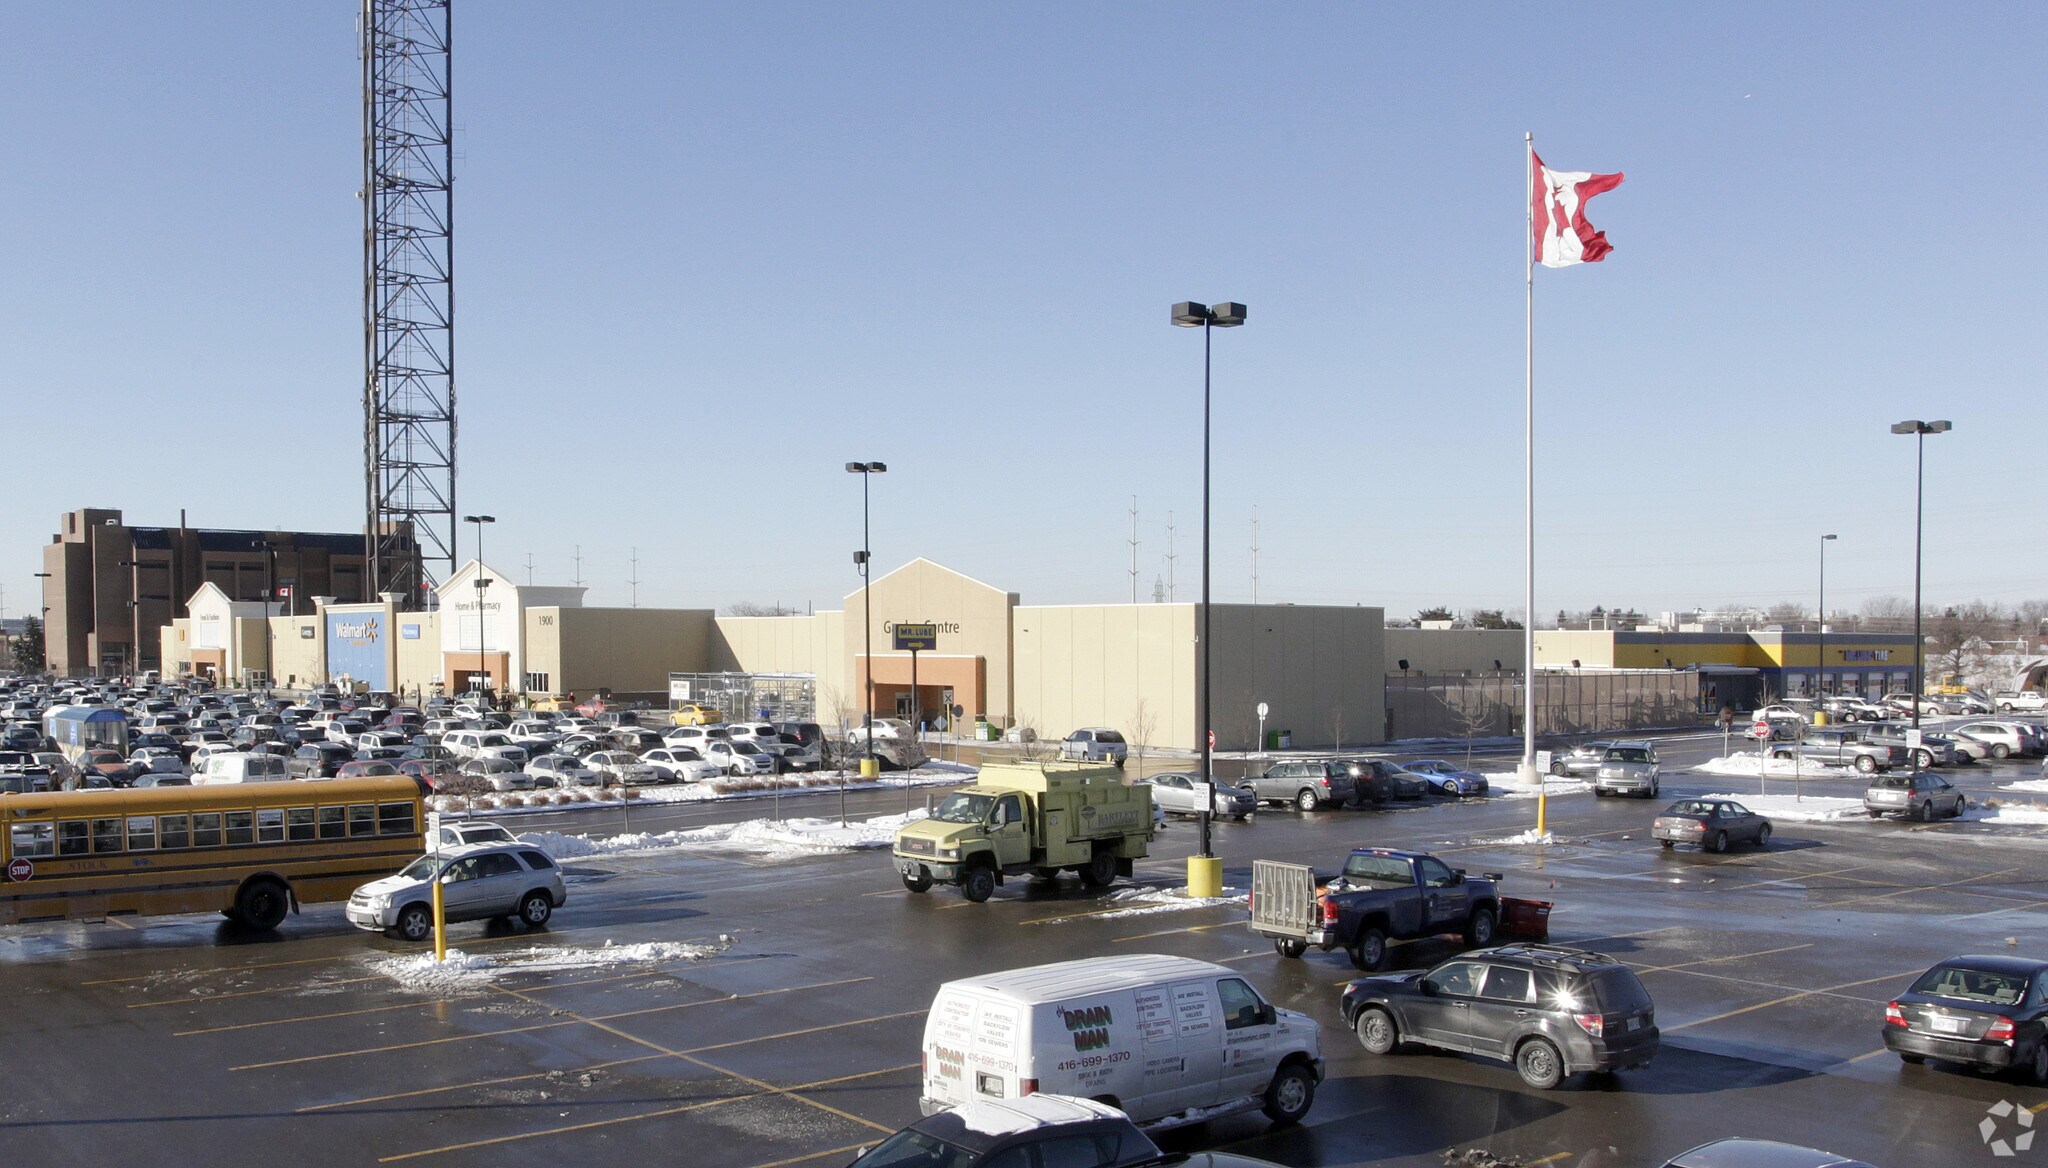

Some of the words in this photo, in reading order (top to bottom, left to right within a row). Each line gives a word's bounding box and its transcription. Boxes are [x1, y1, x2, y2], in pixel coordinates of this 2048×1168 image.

[455, 602, 470, 610] Home
[538, 615, 554, 626] 1900
[335, 622, 368, 638] Walmart
[900, 628, 914, 636] MR.
[915, 628, 933, 636] LUBE
[1873, 650, 1888, 661] TIRE
[1753, 725, 1768, 734] STOP
[12, 865, 30, 876] STOP
[1180, 1003, 1205, 1012] BACKFLOW
[994, 1013, 1013, 1022] INSTALL
[1063, 1005, 1113, 1031] DRAIN
[983, 1020, 1011, 1031] BACKFLOW
[1190, 1022, 1209, 1031] SEWERS
[986, 1029, 1004, 1038] VALVES
[988, 1039, 1008, 1049] SEWERS
[1073, 1028, 1110, 1052] MAN
[936, 1045, 965, 1066] DRAIN
[1057, 1051, 1131, 1071] 416-699-1370
[967, 1051, 1014, 1072] 416-699-1370
[940, 1061, 961, 1081] MAN
